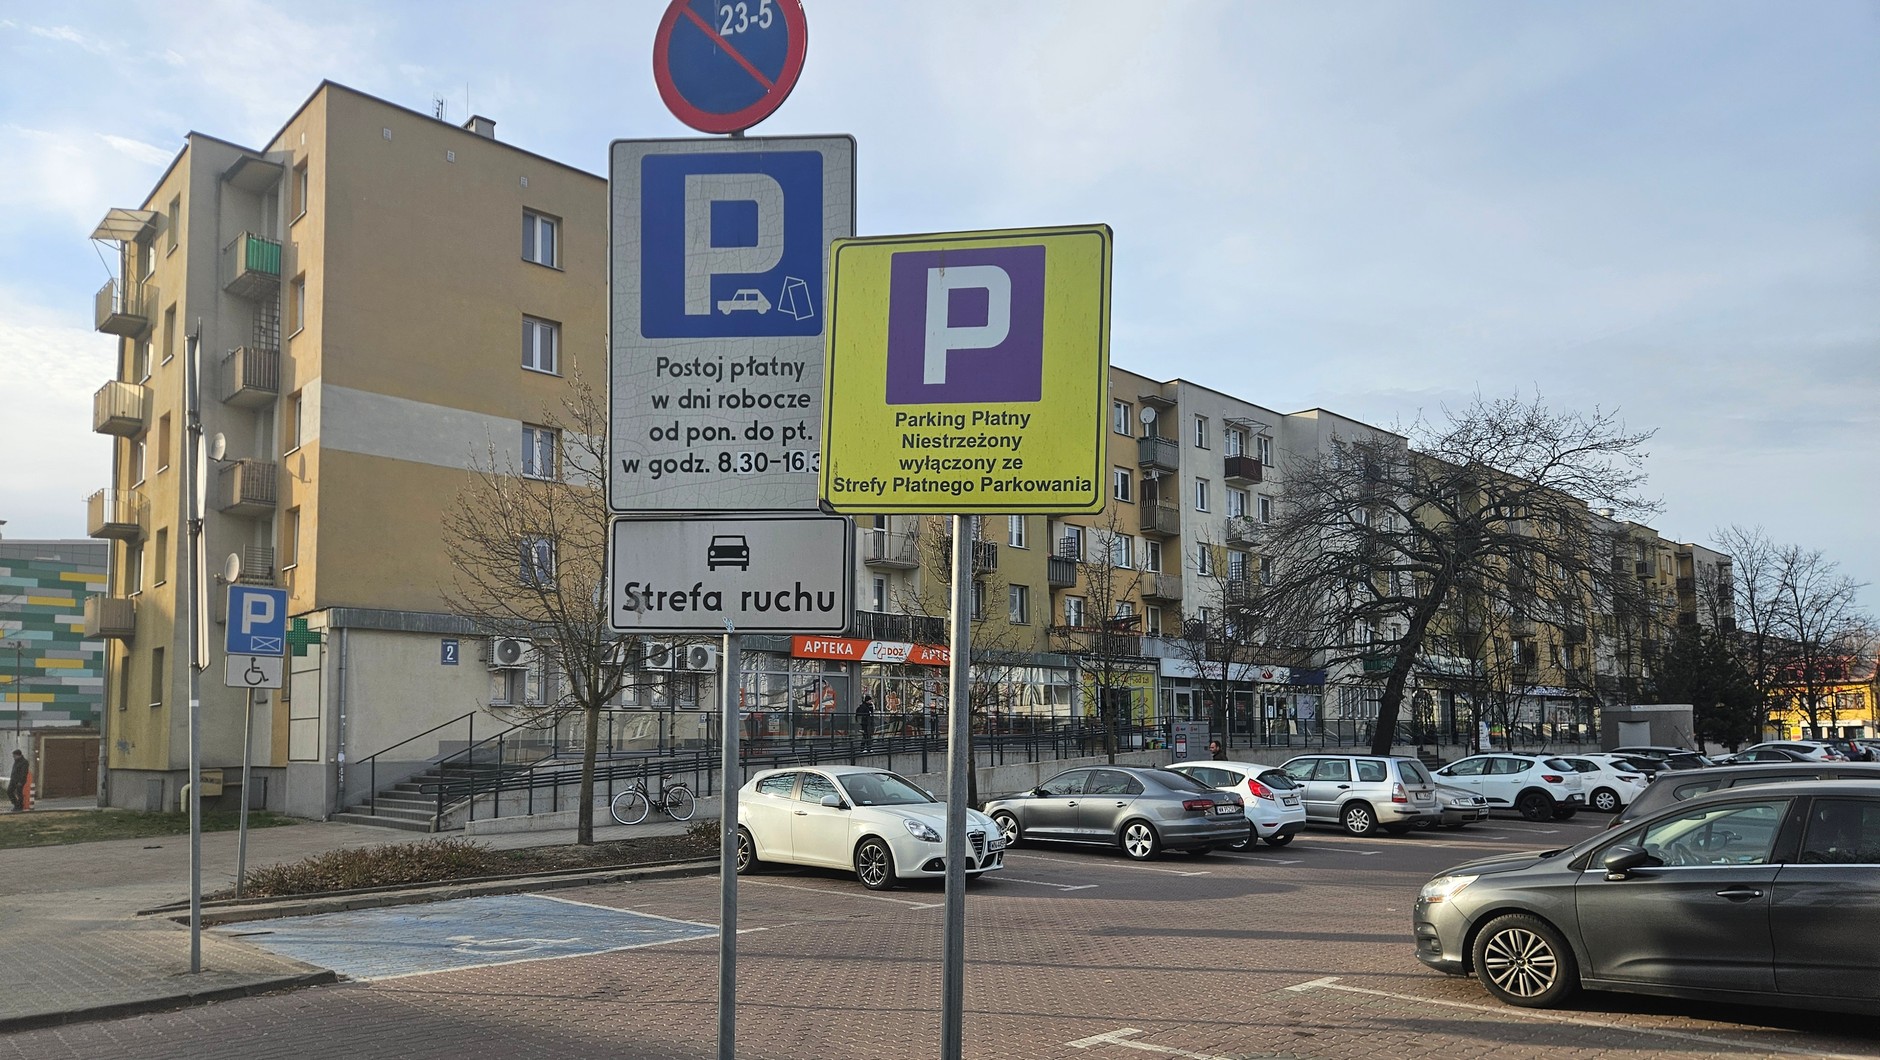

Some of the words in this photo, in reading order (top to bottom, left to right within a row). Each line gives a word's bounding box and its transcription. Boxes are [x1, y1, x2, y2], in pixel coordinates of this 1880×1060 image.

[720, 0, 773, 36] 23-5
[684, 173, 785, 316] P
[923, 265, 1012, 385] P
[656, 356, 723, 383] Postoj
[730, 356, 806, 383] płatny
[651, 394, 670, 409] w
[677, 388, 711, 409] dni
[718, 388, 812, 409] robocze
[895, 412, 966, 429] Parking
[972, 411, 1031, 429] Płatny
[649, 420, 679, 442] od
[686, 427, 737, 448] pon.
[744, 420, 775, 442] do
[782, 420, 813, 447] pt.
[902, 433, 1023, 451] Niestrzeżony
[622, 459, 641, 473] w
[648, 453, 711, 480] godz.
[717, 452, 821, 474] 8.30-16.3
[899, 455, 997, 474] wyłączony
[1002, 457, 1024, 470] ze
[833, 477, 887, 496] Strefy
[892, 477, 975, 496] Płatnego
[980, 476, 1092, 492] Parkowania
[622, 581, 723, 611] Strefa
[741, 581, 835, 612] ruchu
[241, 592, 275, 634] P
[446, 645, 454, 660] 2
[803, 640, 853, 655] APTEKA
[887, 648, 904, 657] DOZ
[921, 648, 950, 662] APTE
